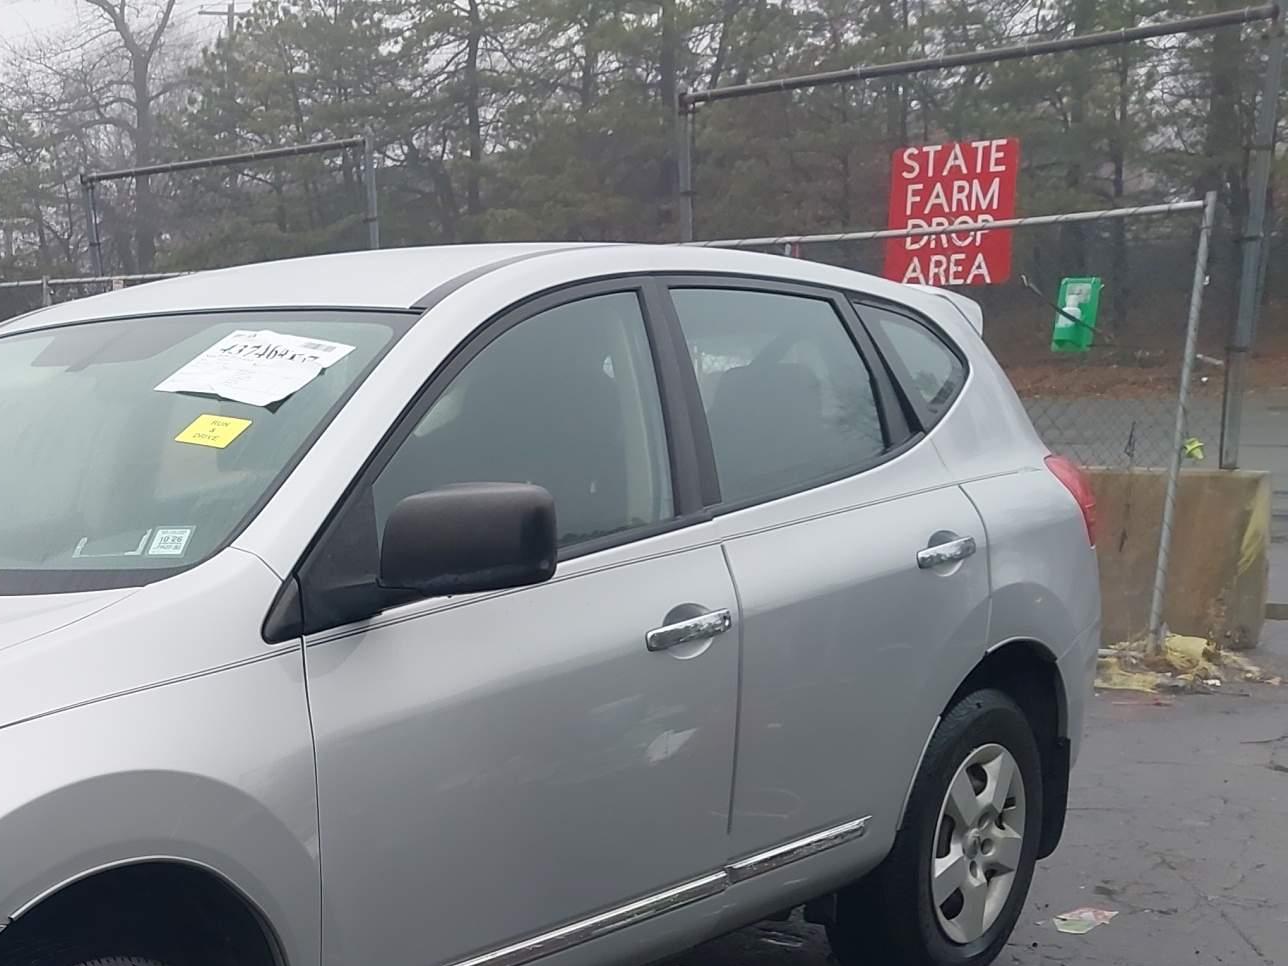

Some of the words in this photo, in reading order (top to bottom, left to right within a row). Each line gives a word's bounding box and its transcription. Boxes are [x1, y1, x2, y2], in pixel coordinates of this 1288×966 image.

[902, 139, 1008, 179] STATE
[905, 177, 1000, 215] FARM
[905, 214, 995, 250] DROP
[902, 252, 992, 285] AREA
